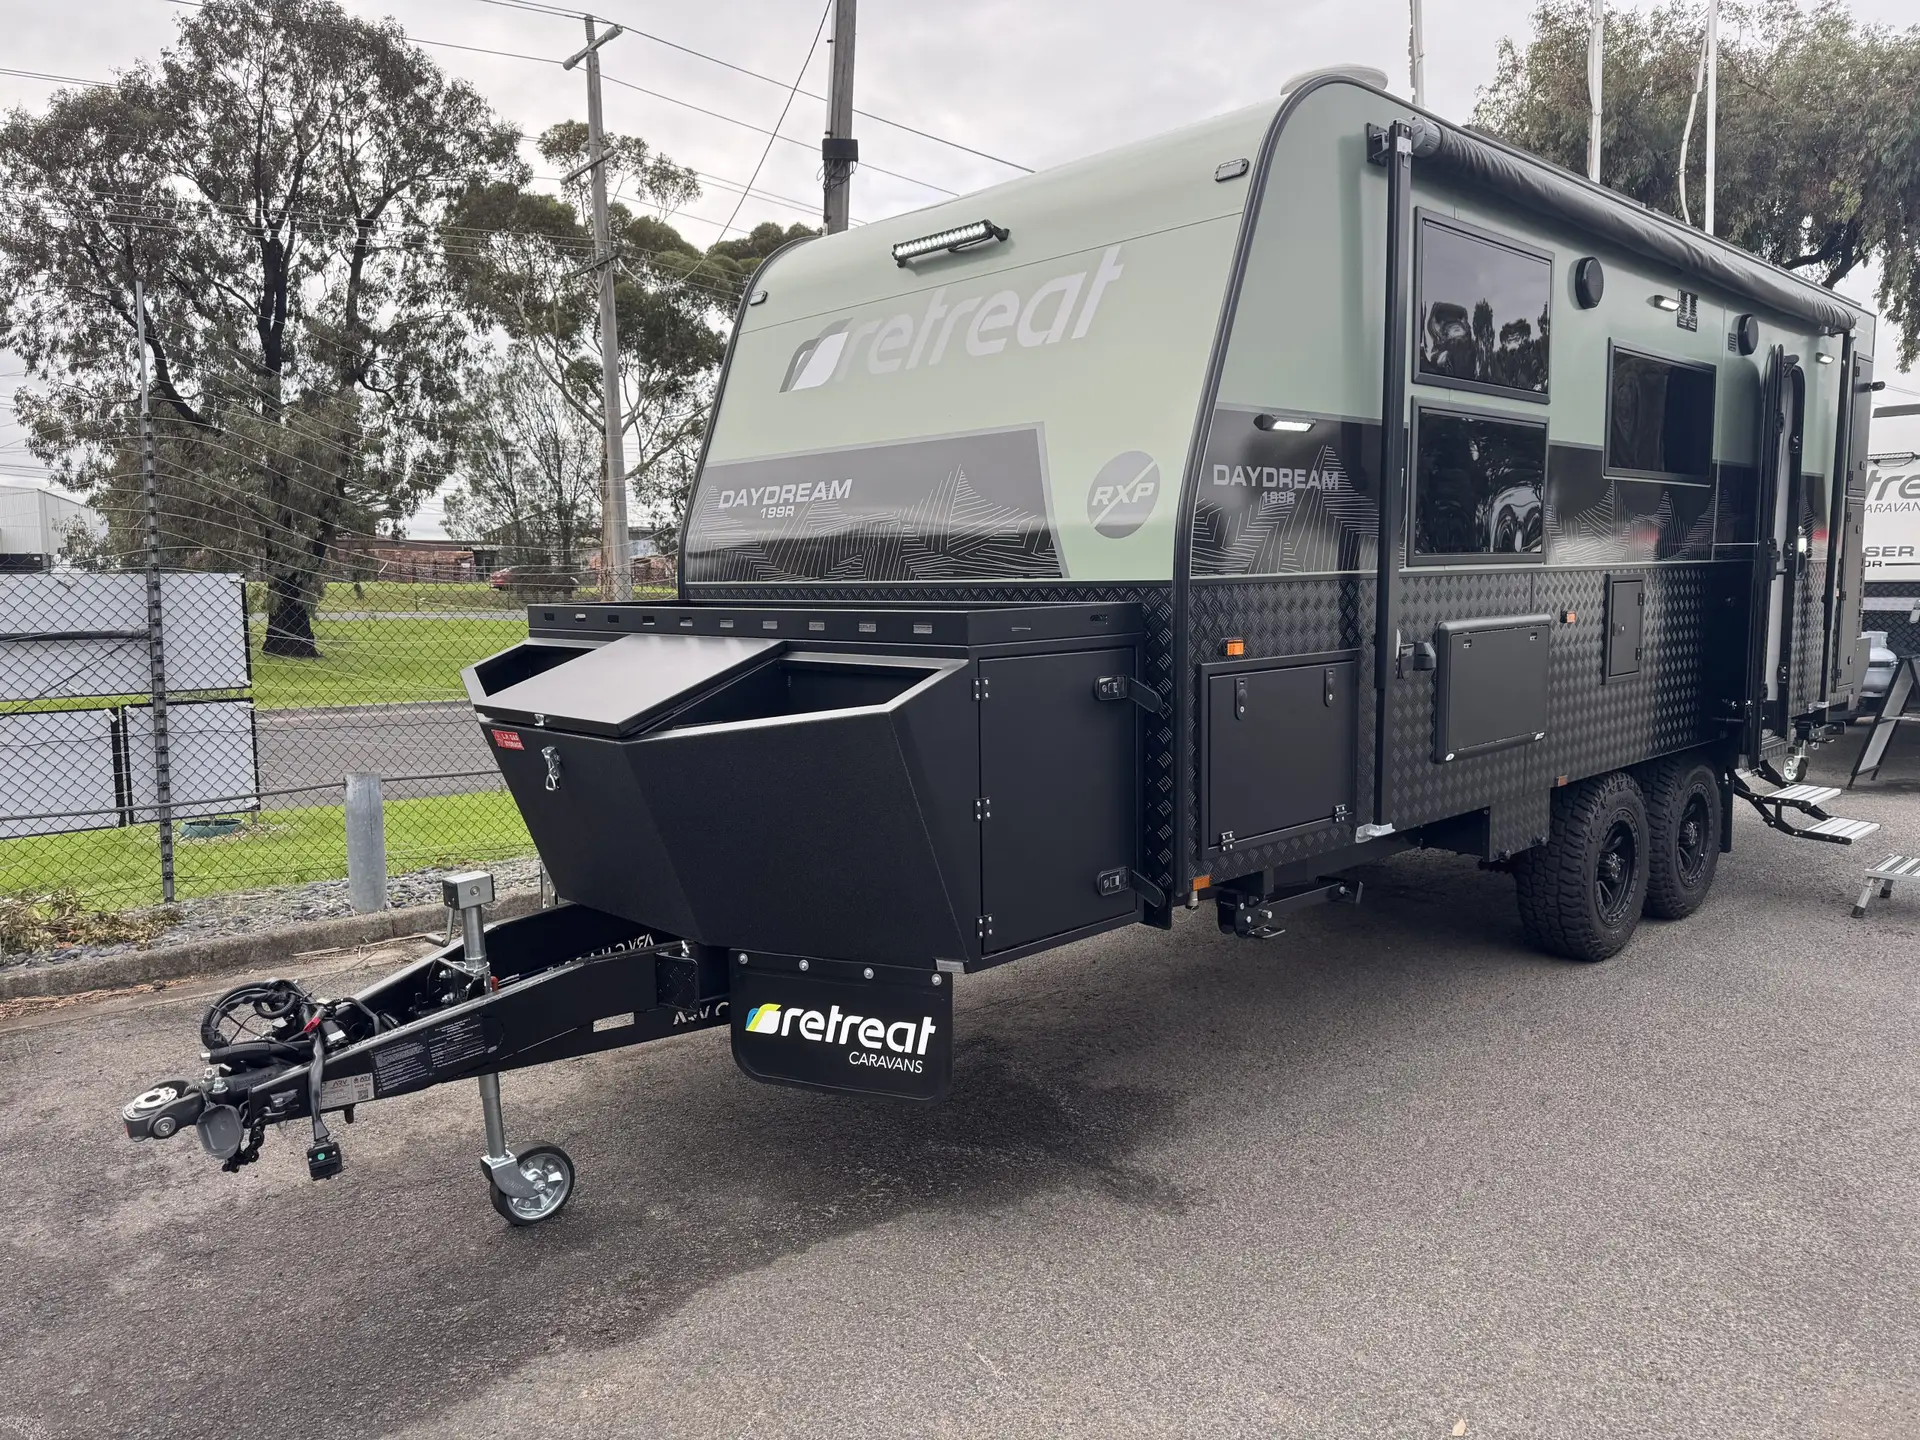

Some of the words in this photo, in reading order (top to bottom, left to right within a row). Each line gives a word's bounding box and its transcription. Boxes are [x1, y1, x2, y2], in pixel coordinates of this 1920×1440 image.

[833, 244, 1124, 383] retreat
[1213, 464, 1339, 490] DAYDREAM
[718, 479, 853, 508] DAYDREAM
[1091, 482, 1155, 506] RXP
[760, 505, 795, 519] 199R
[781, 1005, 937, 1055] retreat
[849, 1051, 923, 1073] CARAVANS
